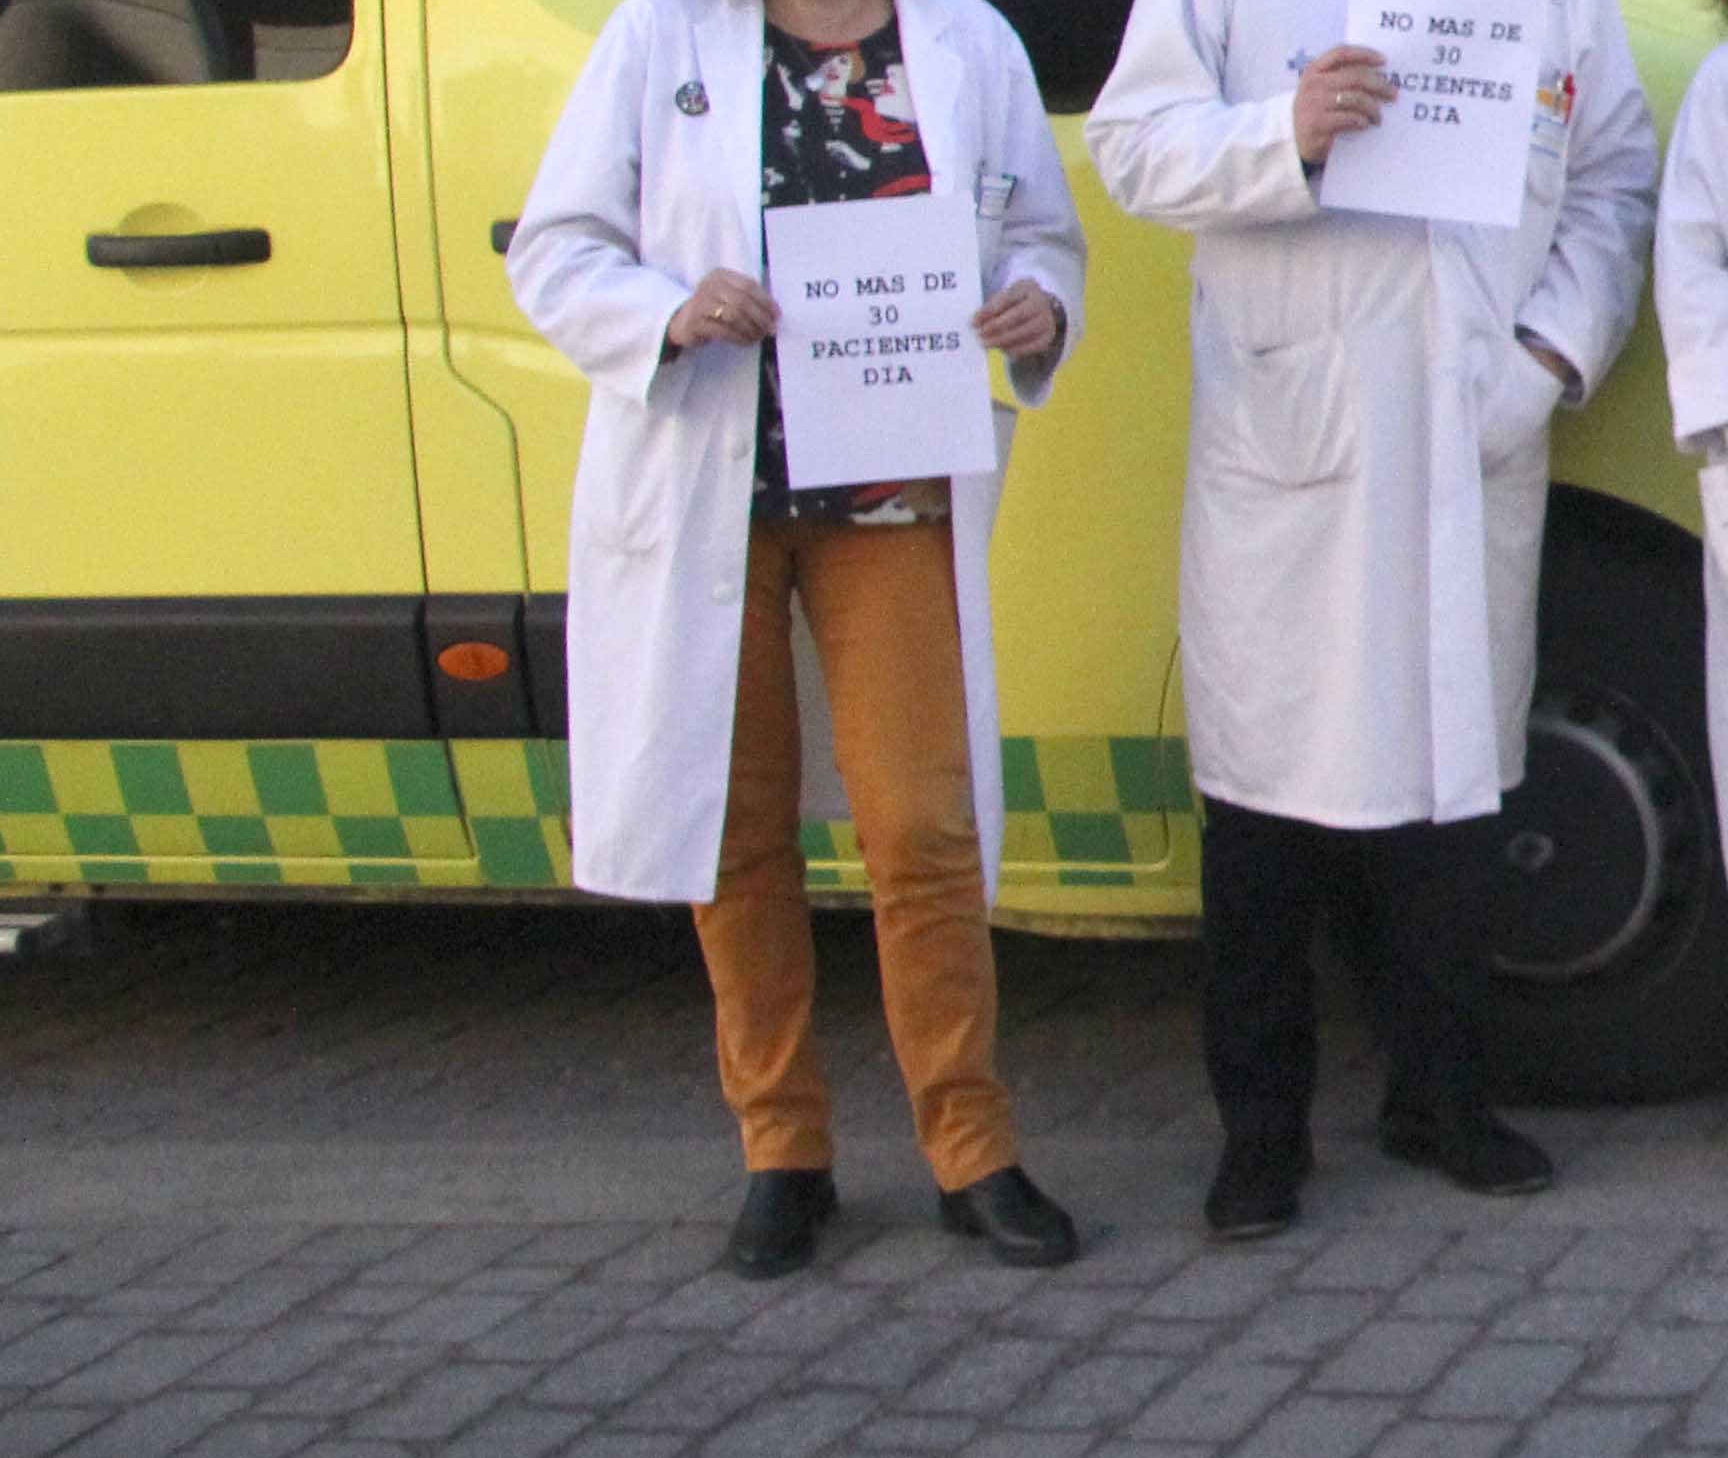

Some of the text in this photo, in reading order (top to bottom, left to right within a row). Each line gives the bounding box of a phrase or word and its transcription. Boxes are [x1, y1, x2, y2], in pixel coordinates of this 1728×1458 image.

[1380, 11, 1522, 42] NO MAS DE
[1433, 45, 1462, 65] 30
[1413, 103, 1460, 125] DIA
[805, 270, 957, 299] NO MAS DE
[869, 305, 899, 326] 30
[811, 332, 961, 360] PACIENTES
[864, 366, 913, 386] DIA
